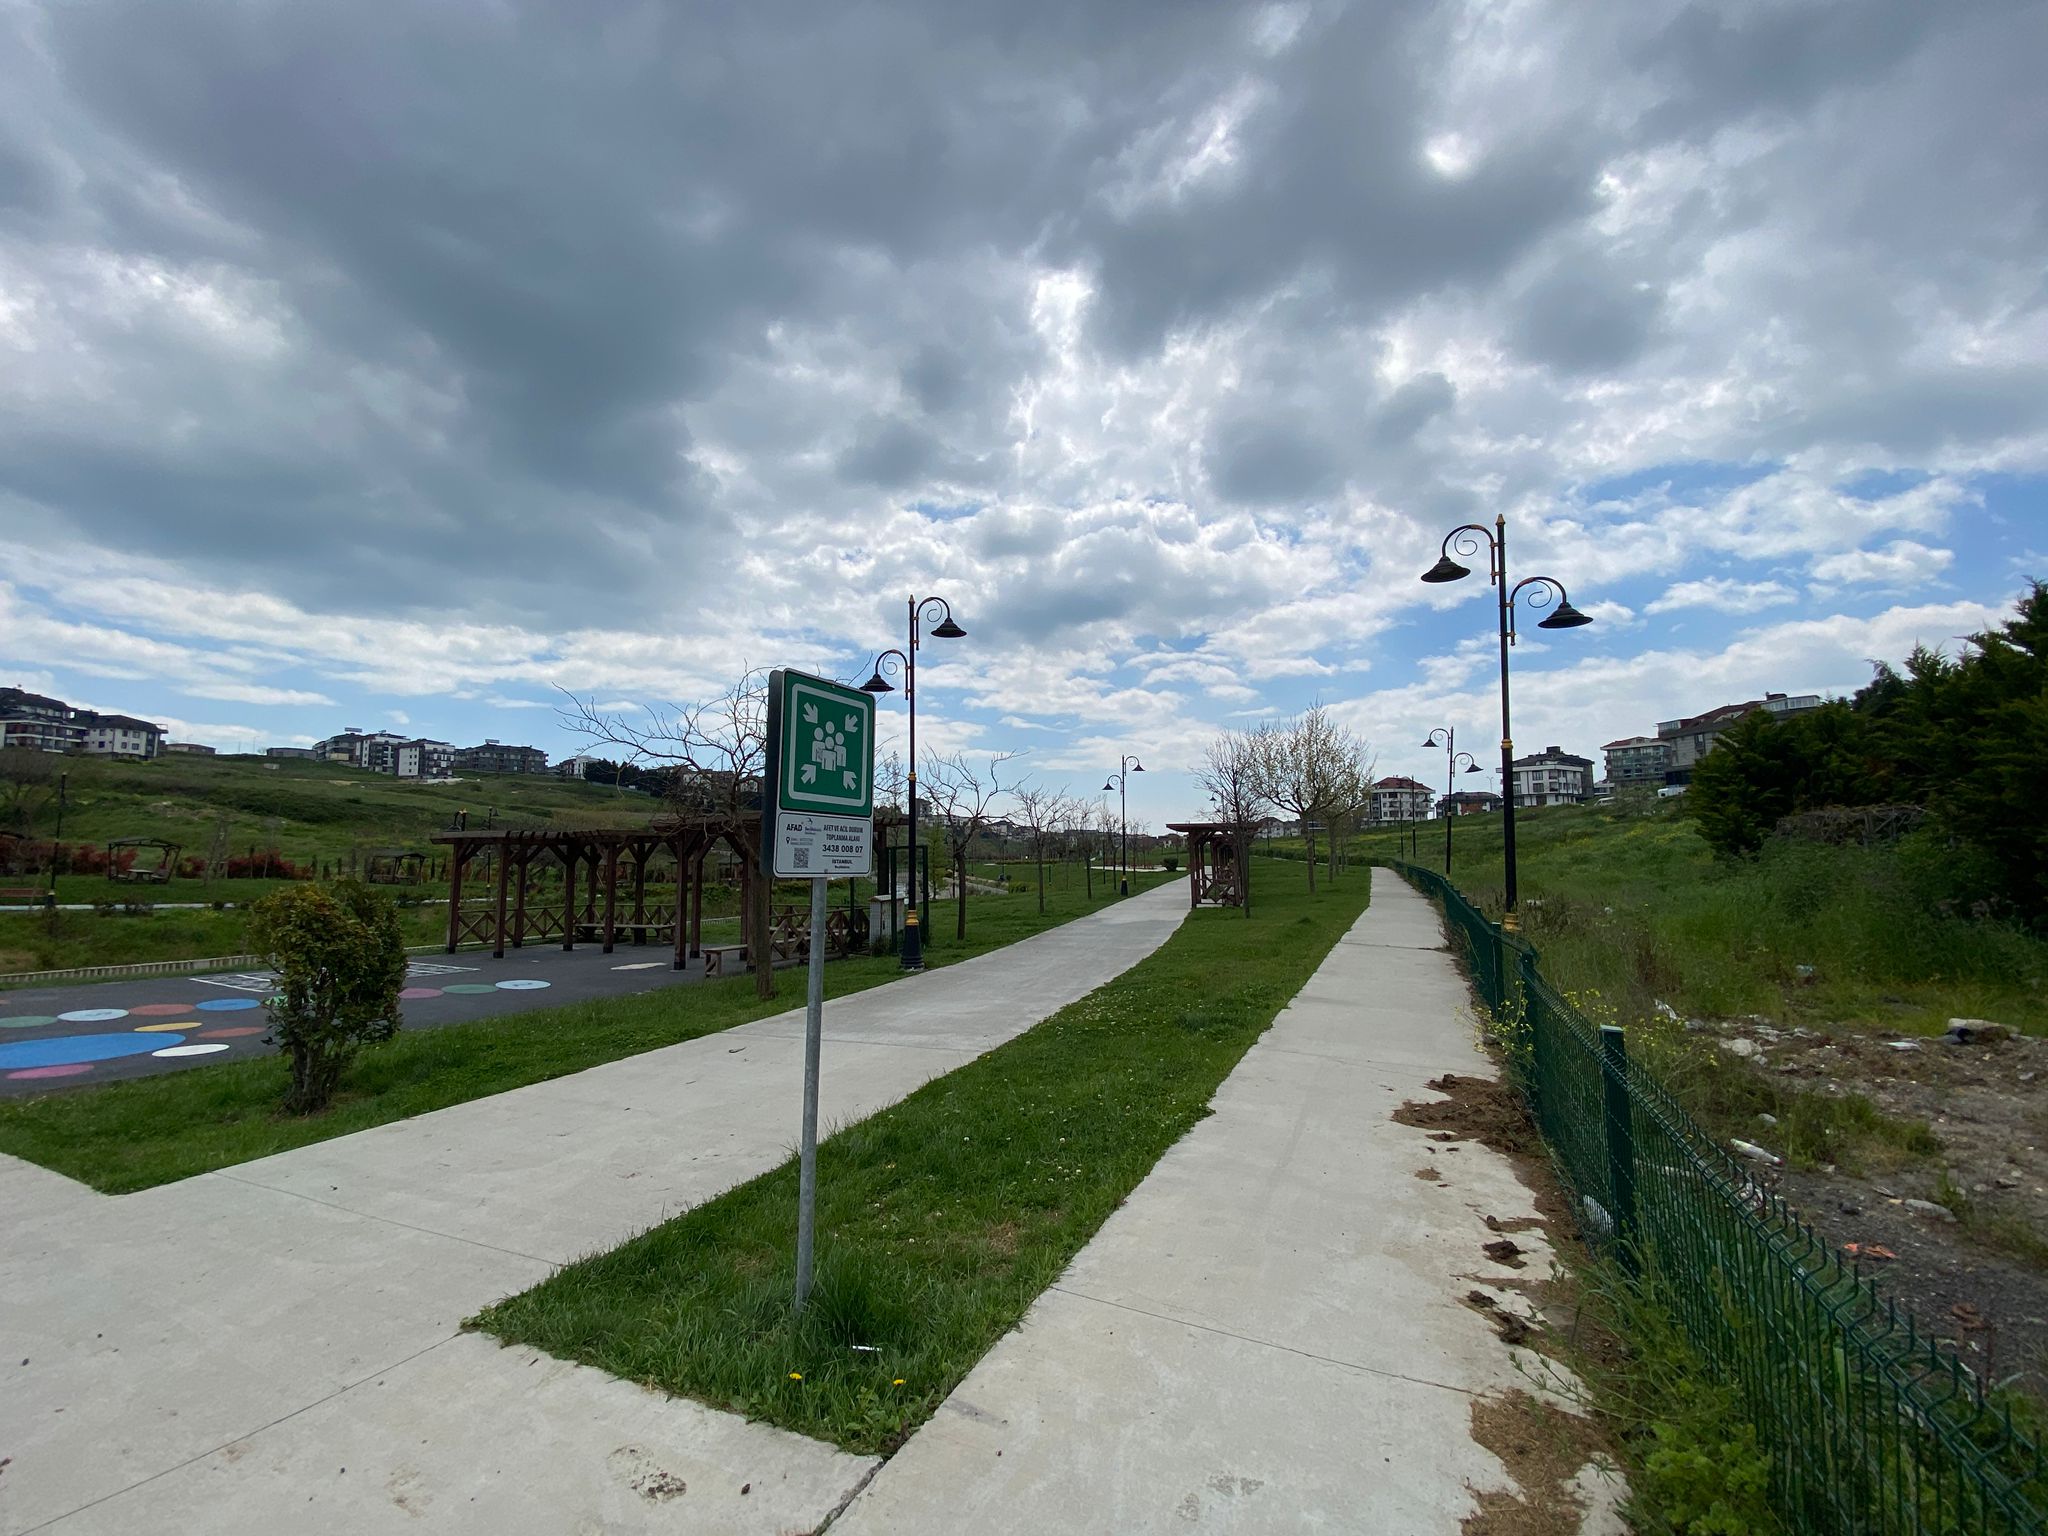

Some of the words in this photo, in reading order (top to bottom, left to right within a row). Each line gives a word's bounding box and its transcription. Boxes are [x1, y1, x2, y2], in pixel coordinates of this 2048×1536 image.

[822, 844, 839, 852] 3438
[841, 845, 853, 853] 008
[855, 845, 863, 853] 07
